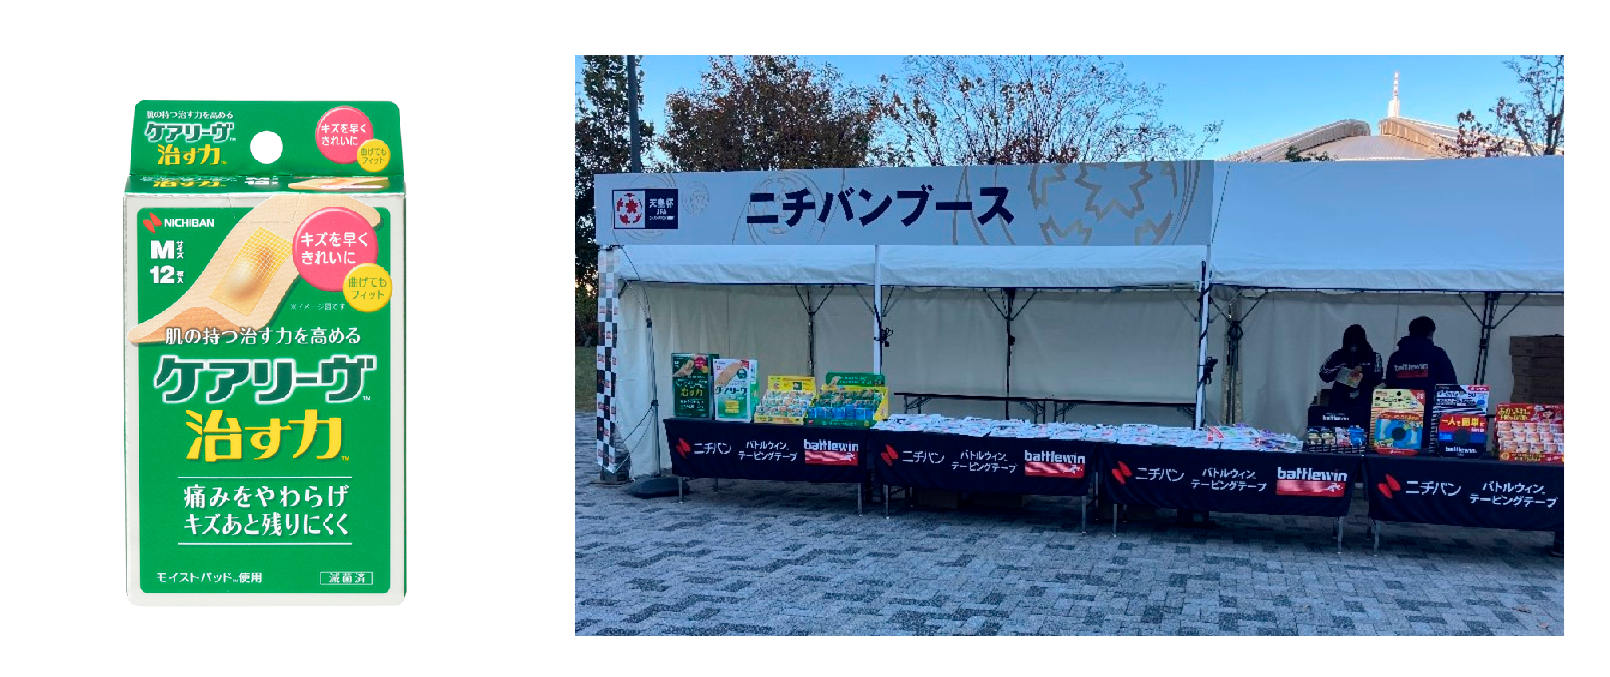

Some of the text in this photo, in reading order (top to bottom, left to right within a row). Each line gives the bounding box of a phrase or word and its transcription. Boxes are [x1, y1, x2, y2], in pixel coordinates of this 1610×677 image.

[146, 110, 234, 119] 肌の持つ治す力を高める
[321, 123, 367, 134] キズを早く
[321, 136, 358, 146] きれいに
[157, 144, 221, 165] 治す力
[360, 147, 387, 157] 曲げても
[361, 156, 385, 165] フィット
[746, 184, 1015, 227] ニチバンブース
[164, 218, 215, 228] NICHIBAN
[300, 232, 369, 247] キズを早く
[150, 240, 175, 259] M
[301, 250, 357, 265] きれいに
[150, 265, 175, 284] 12
[348, 277, 387, 288] 曲げても
[351, 290, 385, 300] フィット
[165, 327, 361, 345] 肌の持つ治す力を高める
[185, 409, 342, 462] 治す力
[694, 442, 732, 455] ニチバン
[803, 438, 859, 452] battlewin
[902, 450, 944, 464] ニチバン
[1024, 450, 1085, 464] battlewin
[1135, 467, 1185, 482] ニチバン
[1277, 467, 1348, 481] battlewin
[1405, 480, 1462, 497] ニチバン
[184, 484, 350, 508] 痛みをやわらげ
[1470, 493, 1558, 509] テーピングテープ
[184, 512, 349, 536] キズあと残りにくく
